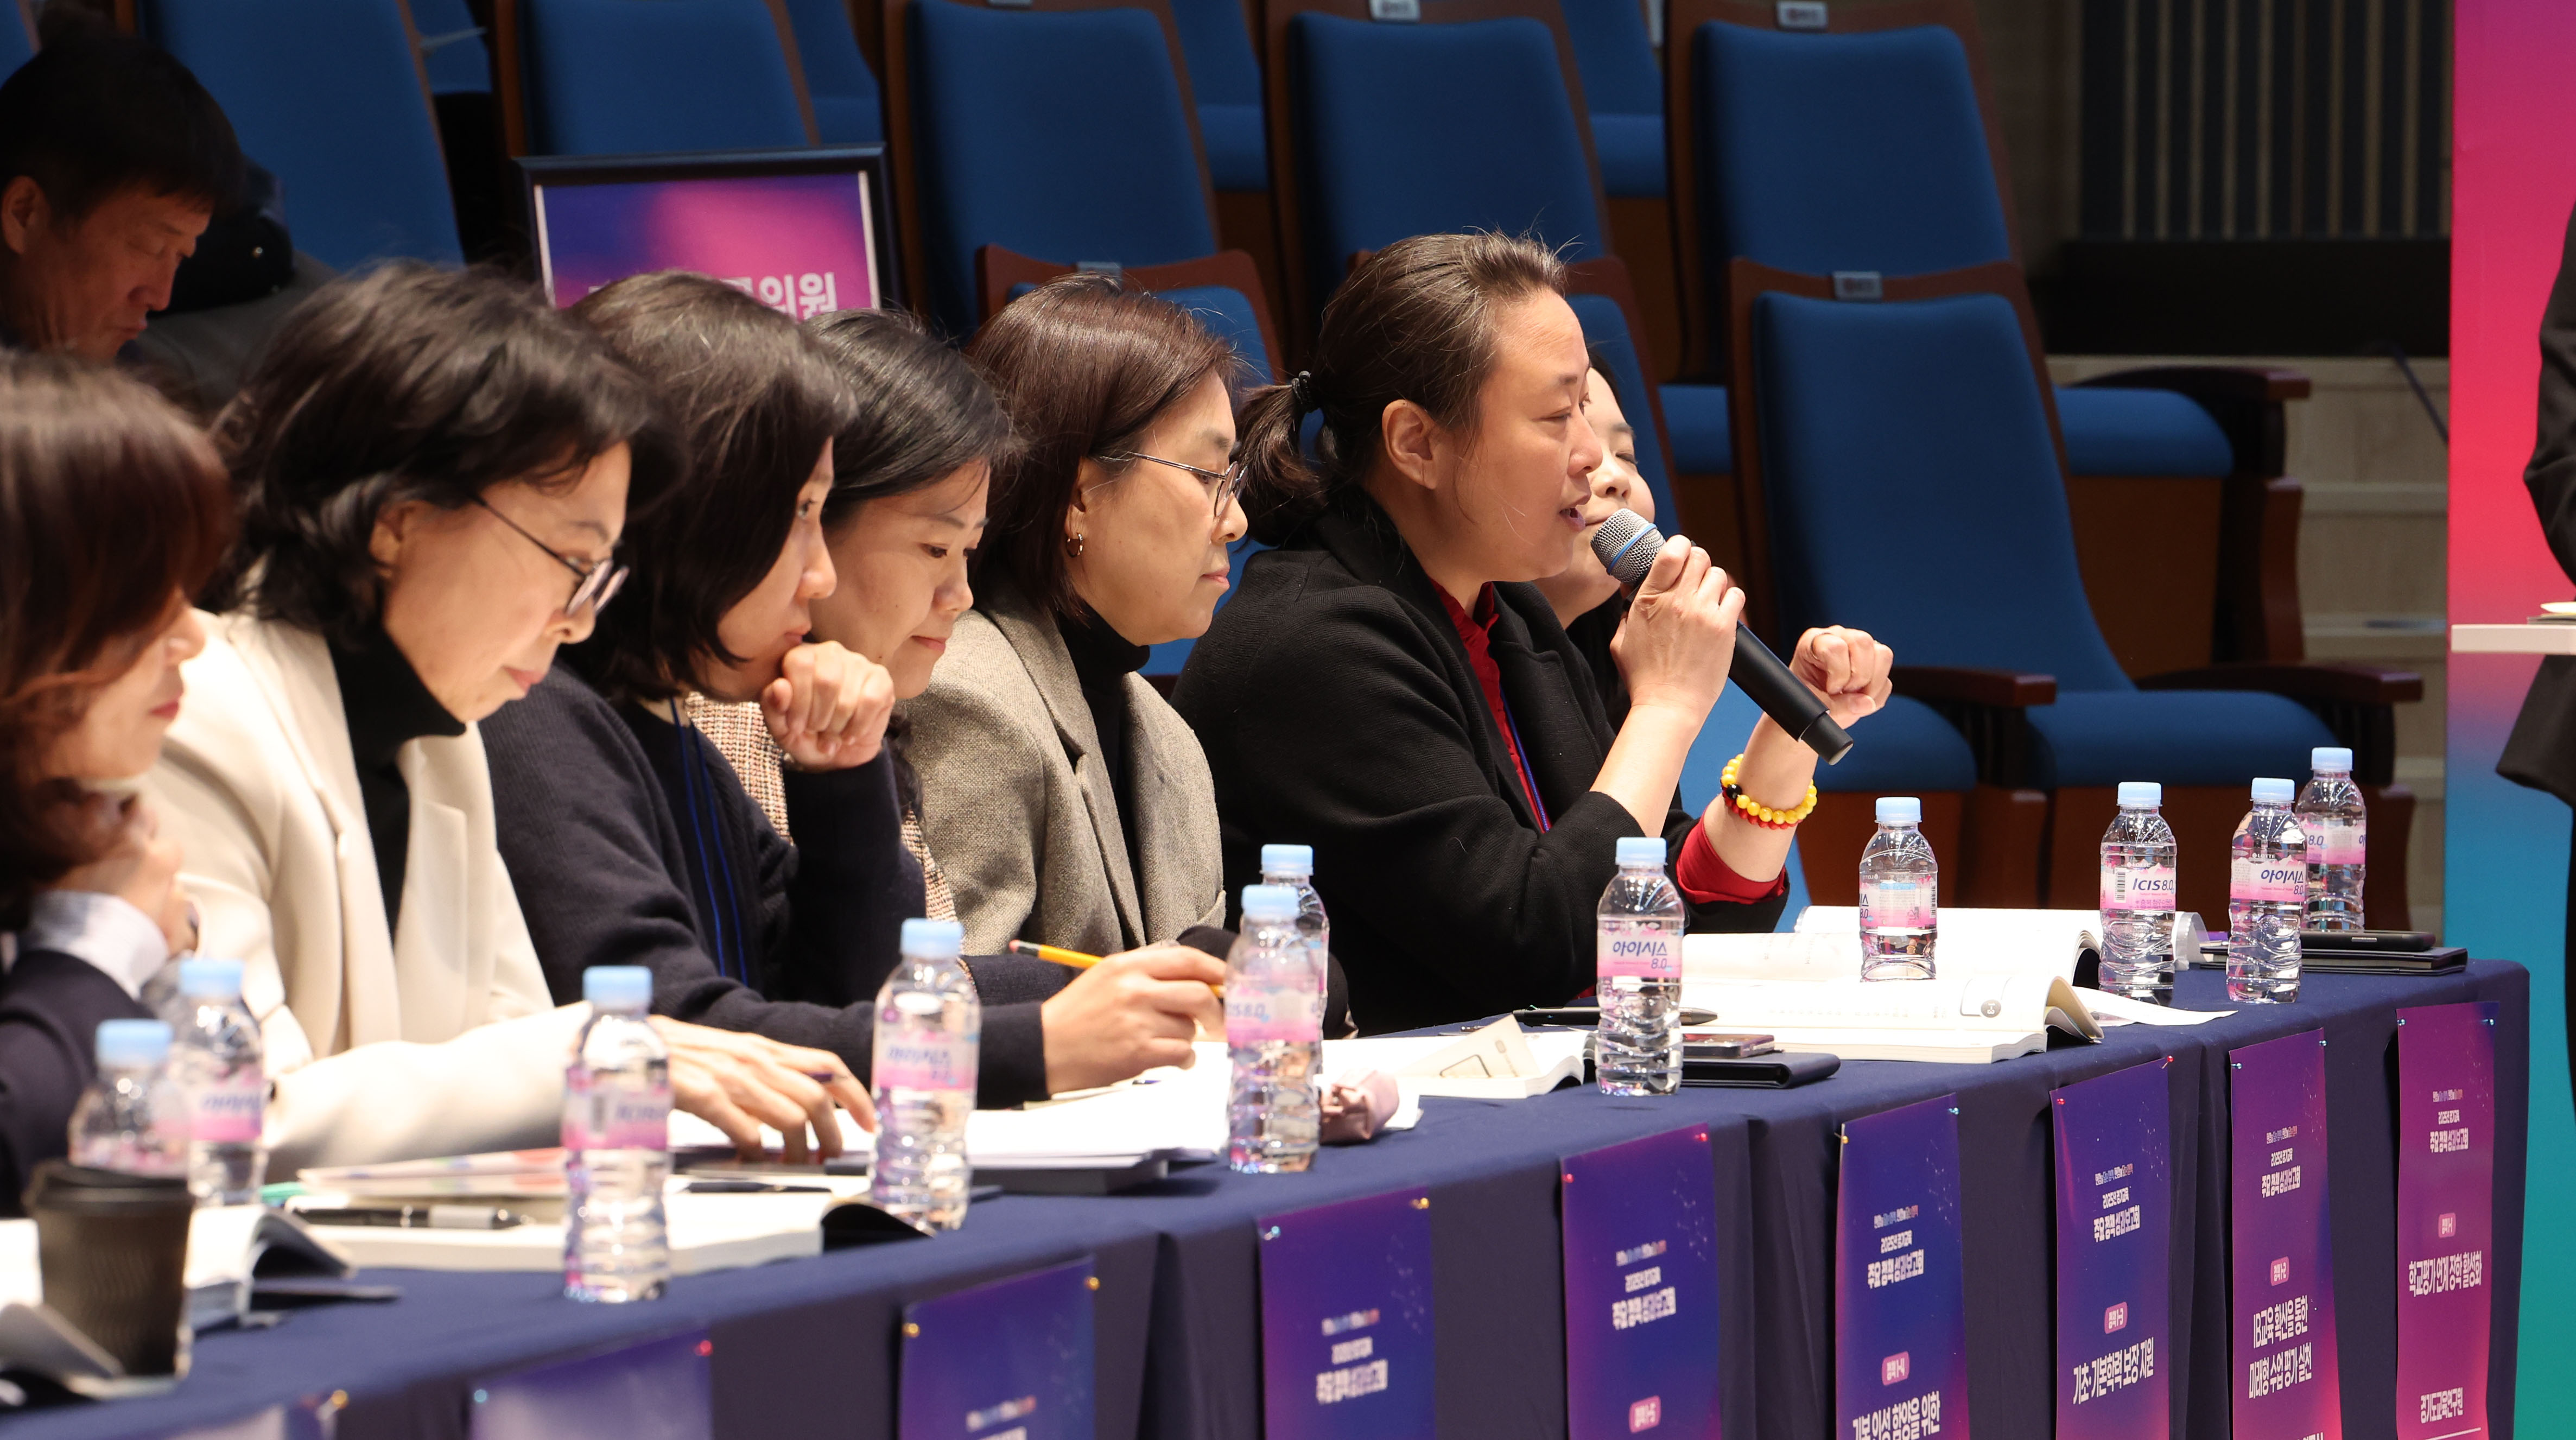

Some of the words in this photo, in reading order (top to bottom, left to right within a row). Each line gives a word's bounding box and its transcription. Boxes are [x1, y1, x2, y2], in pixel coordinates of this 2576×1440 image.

[2133, 878, 2161, 891] ICIS
[2162, 879, 2173, 891] 8.0
[2261, 870, 2304, 884] 아이시스
[2293, 885, 2304, 895] 8.0
[1613, 941, 1667, 956] 아이시스
[1651, 958, 1667, 969] 8.0
[2409, 1258, 2435, 1297] 학교평가
[2437, 1255, 2449, 1293] 연계
[2450, 1253, 2462, 1290] 장학
[2463, 1250, 2482, 1289] 활성화
[2254, 1306, 2274, 1349] IB교육
[2275, 1299, 2294, 1342] 확산을
[2295, 1295, 2308, 1335] 통한
[2123, 1343, 2140, 1386] 보장
[2140, 1336, 2154, 1379] 지원
[2249, 1356, 2269, 1399] 미래형
[2270, 1352, 2283, 1393] 수업
[2284, 1347, 2298, 1387] 평가
[2299, 1342, 2312, 1382] 실천
[1872, 1406, 1891, 1440] 인성
[1892, 1397, 1920, 1440] 함양을
[1921, 1390, 1940, 1437] 위한
[2420, 1387, 2463, 1424] 경기도교육연구원
